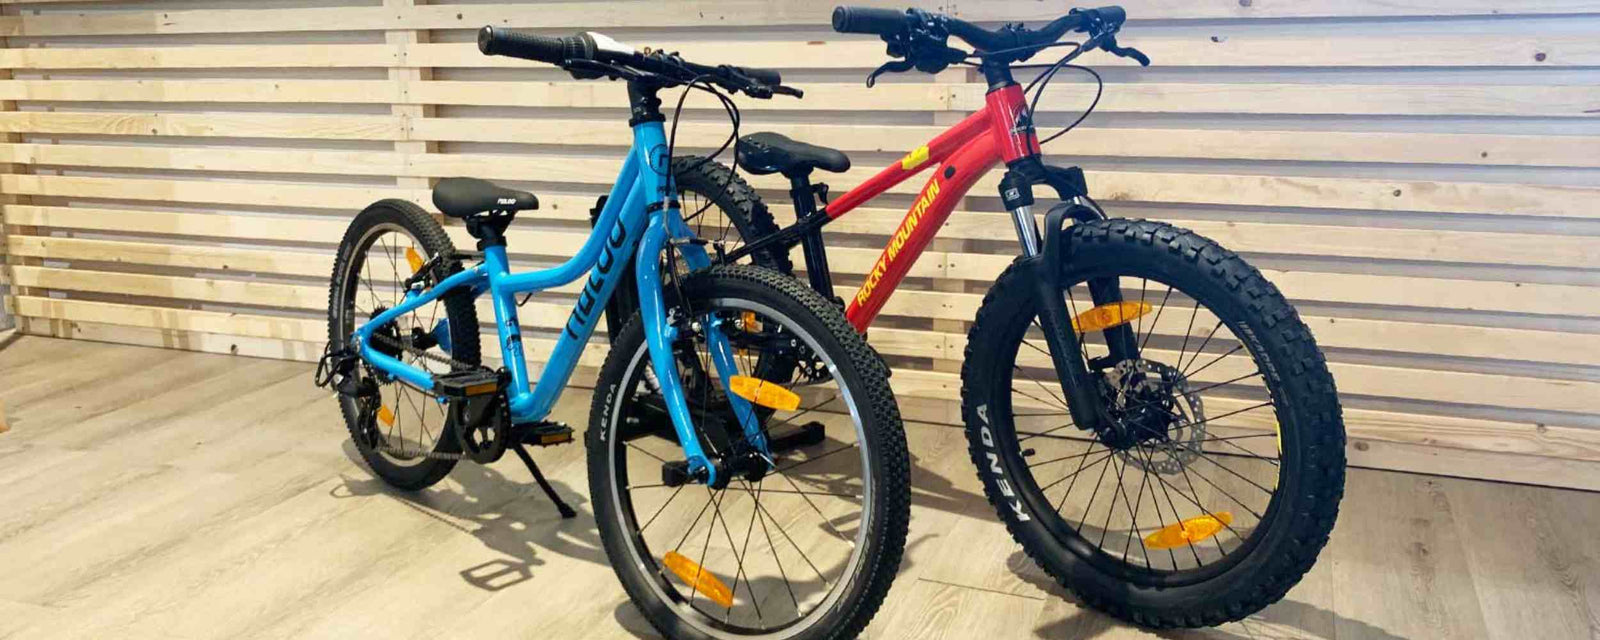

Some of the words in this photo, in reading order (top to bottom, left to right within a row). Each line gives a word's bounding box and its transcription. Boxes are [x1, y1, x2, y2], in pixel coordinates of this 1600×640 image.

[857, 255, 887, 307] ROCKY
[887, 178, 940, 262] MOUNTAIN
[599, 384, 616, 441] KENDA
[976, 403, 1031, 521] KENDA
